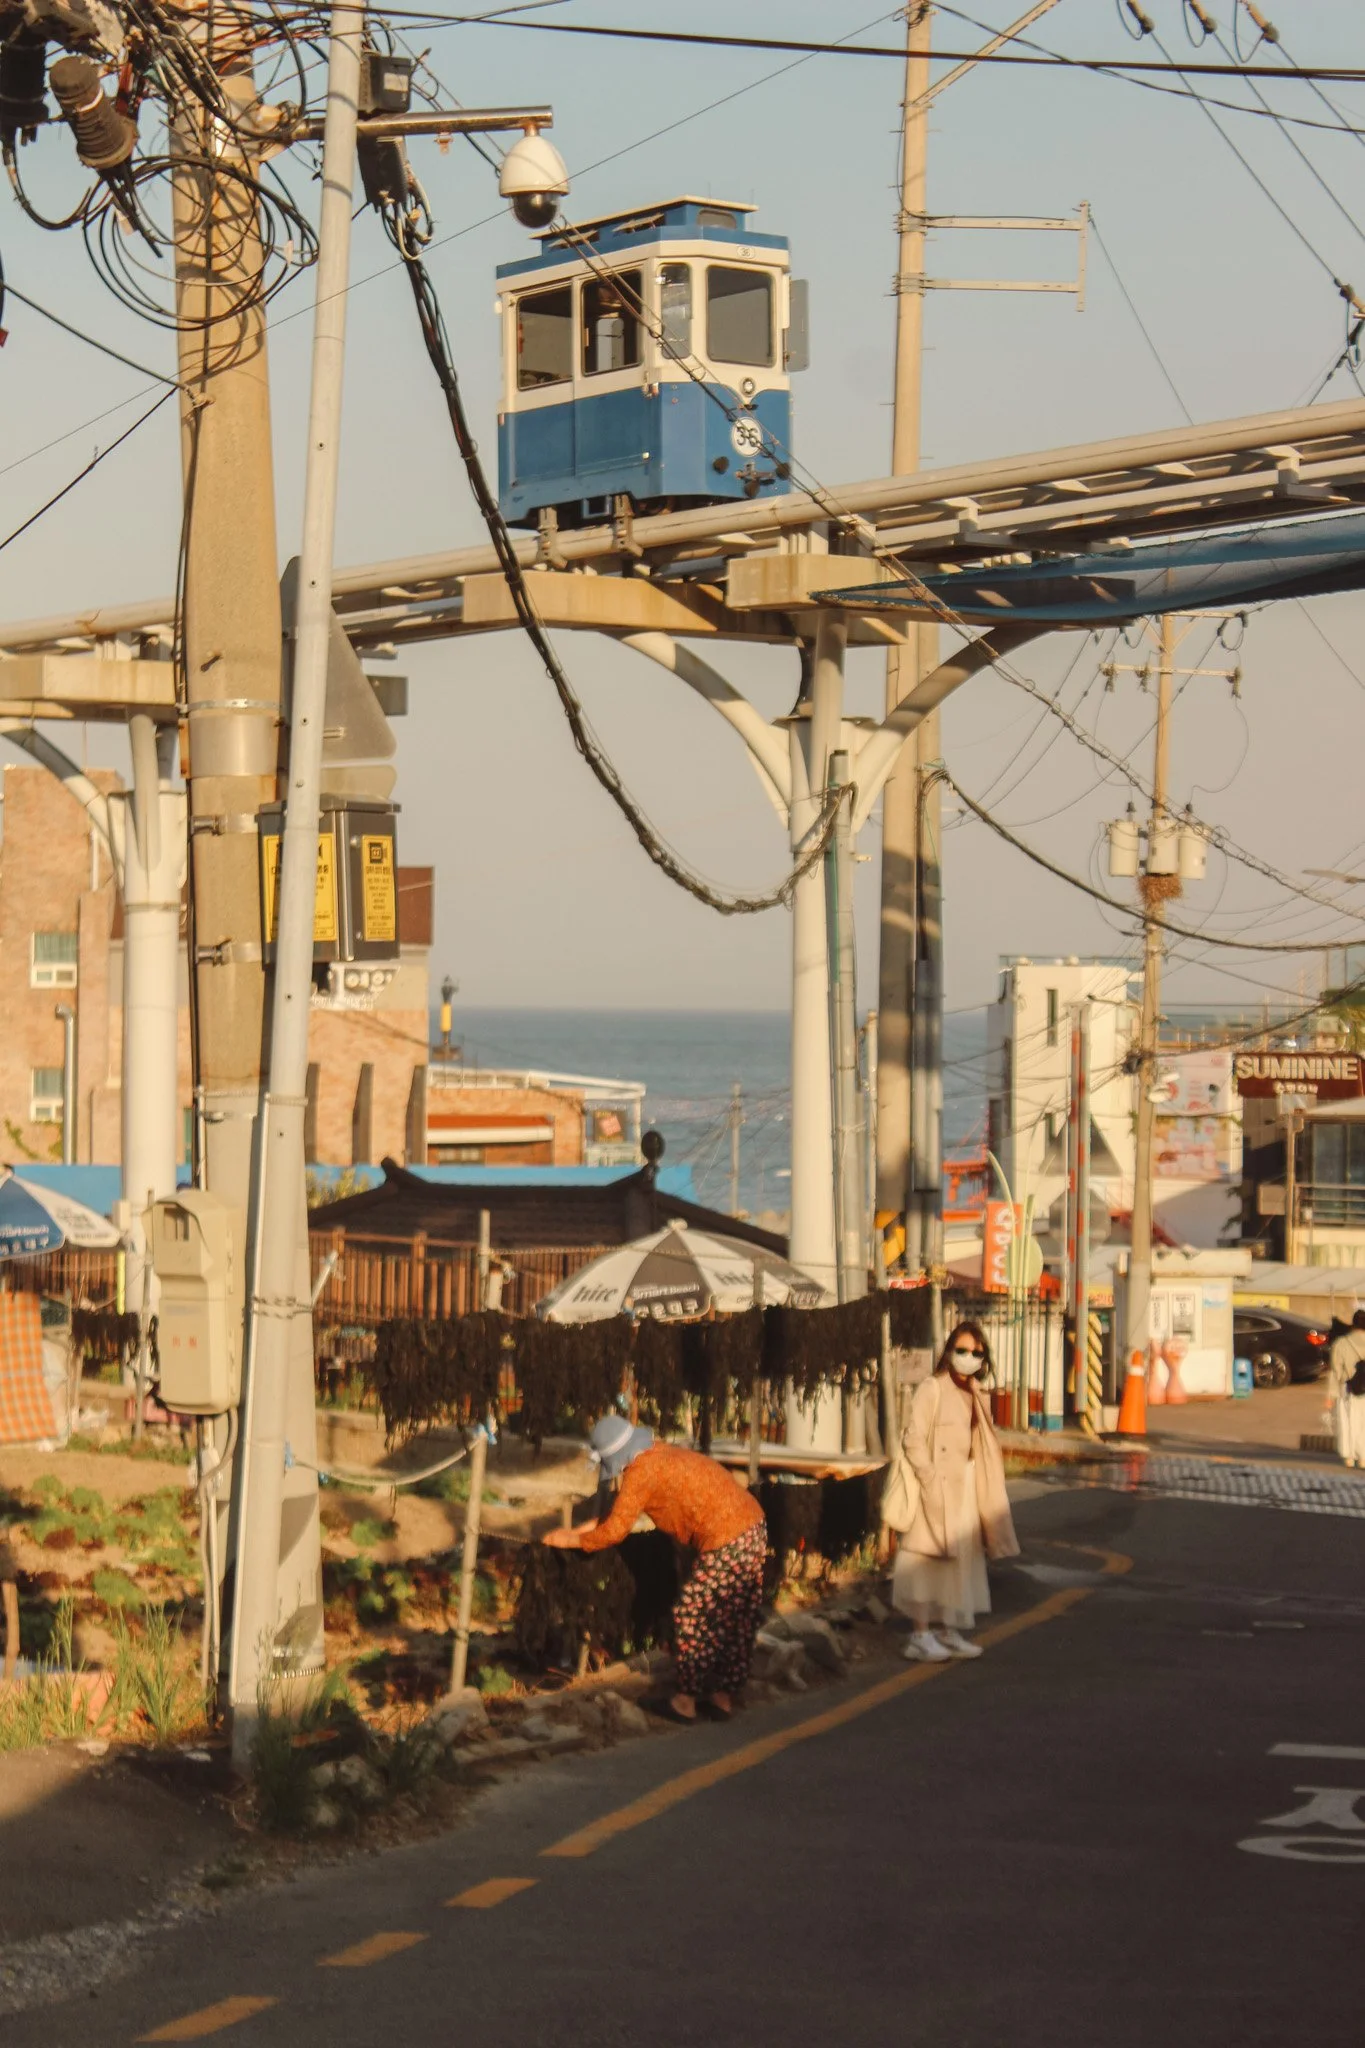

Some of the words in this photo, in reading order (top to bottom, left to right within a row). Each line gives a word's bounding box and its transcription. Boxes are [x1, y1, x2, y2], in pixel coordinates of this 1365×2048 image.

[736, 425, 759, 448] 36
[1236, 1056, 1359, 1080] SUMININE
[669, 1283, 700, 1295] Beach
